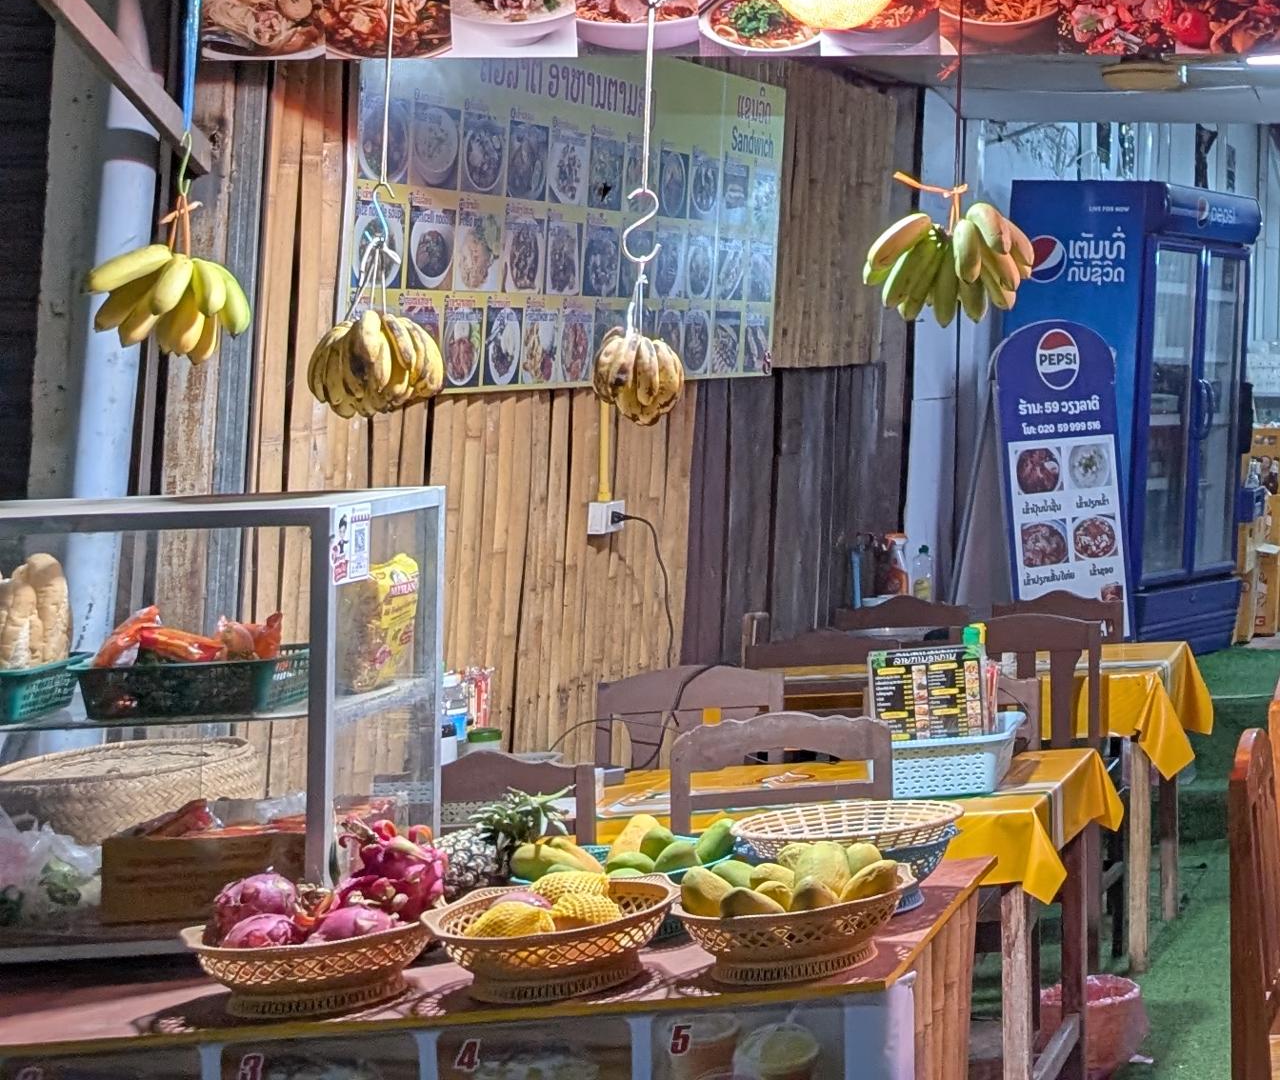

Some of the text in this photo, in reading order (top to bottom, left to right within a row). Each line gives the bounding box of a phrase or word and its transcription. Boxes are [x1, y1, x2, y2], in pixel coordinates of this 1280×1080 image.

[730, 124, 775, 160] Sandwich
[1210, 206, 1236, 224] pepsi
[1039, 353, 1076, 366] PEPSI
[1045, 401, 1059, 413] 59
[1038, 424, 1055, 433] 020
[1057, 423, 1069, 432] 59
[669, 1024, 692, 1056] 5
[455, 1038, 481, 1071] 4
